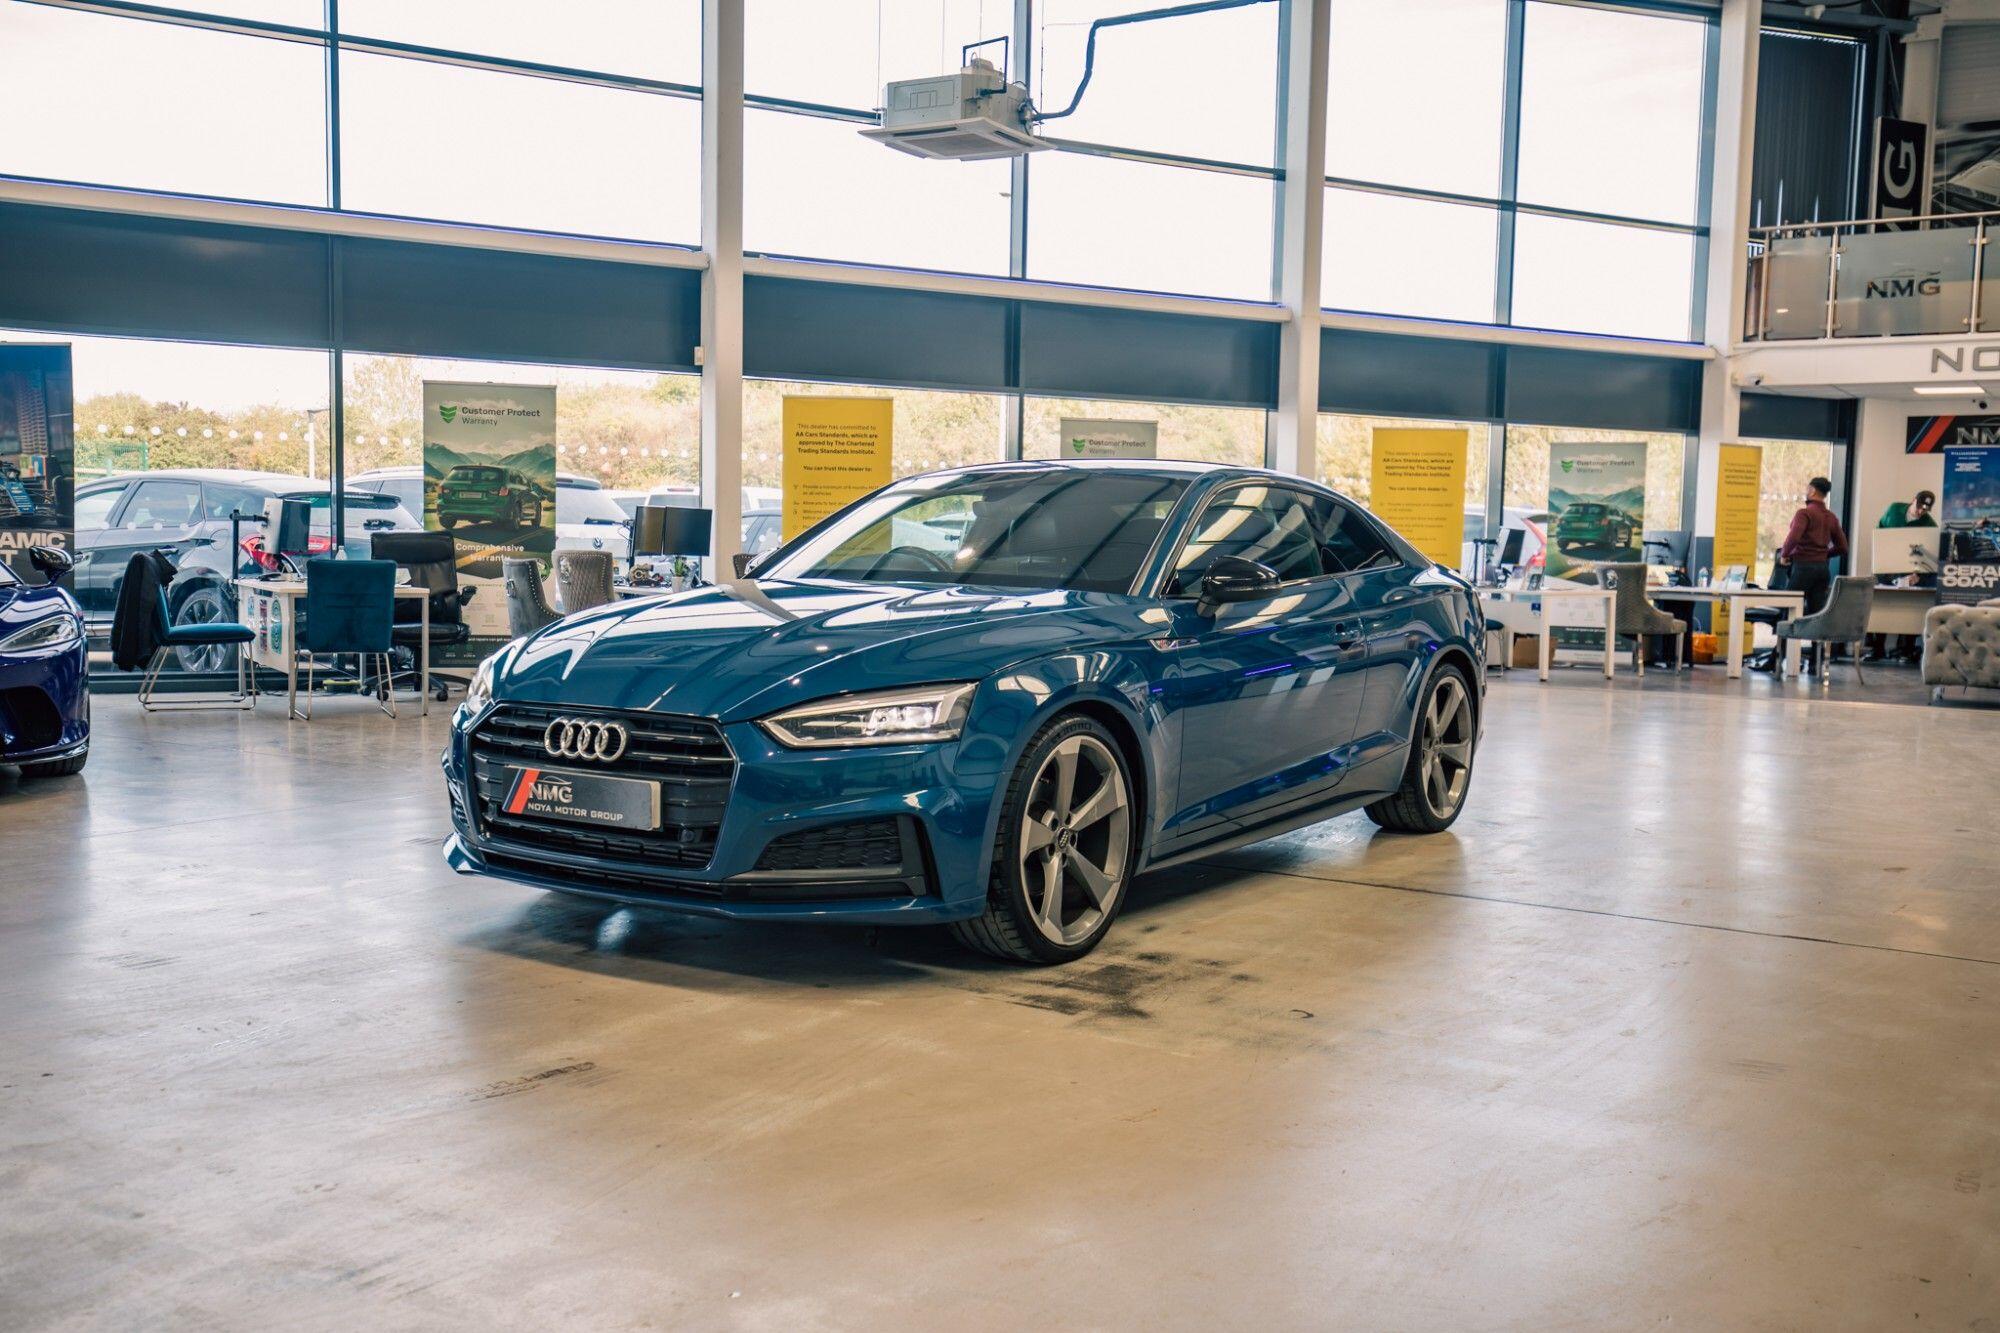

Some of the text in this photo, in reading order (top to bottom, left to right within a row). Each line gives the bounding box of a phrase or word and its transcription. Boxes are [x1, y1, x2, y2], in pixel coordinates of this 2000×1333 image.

[1866, 278, 1941, 298] NMG
[1931, 346, 2000, 374] NO
[462, 406, 541, 417] Customer Protect
[462, 417, 498, 426] Warranty
[1089, 439, 1146, 448] Customer Protect
[0, 532, 66, 549] AMIC
[455, 542, 525, 553] Comprehensive
[1942, 576, 1999, 588] COAT
[528, 782, 573, 803] NMG
[555, 806, 588, 818] MOTOR
[590, 811, 623, 822] GROUP
